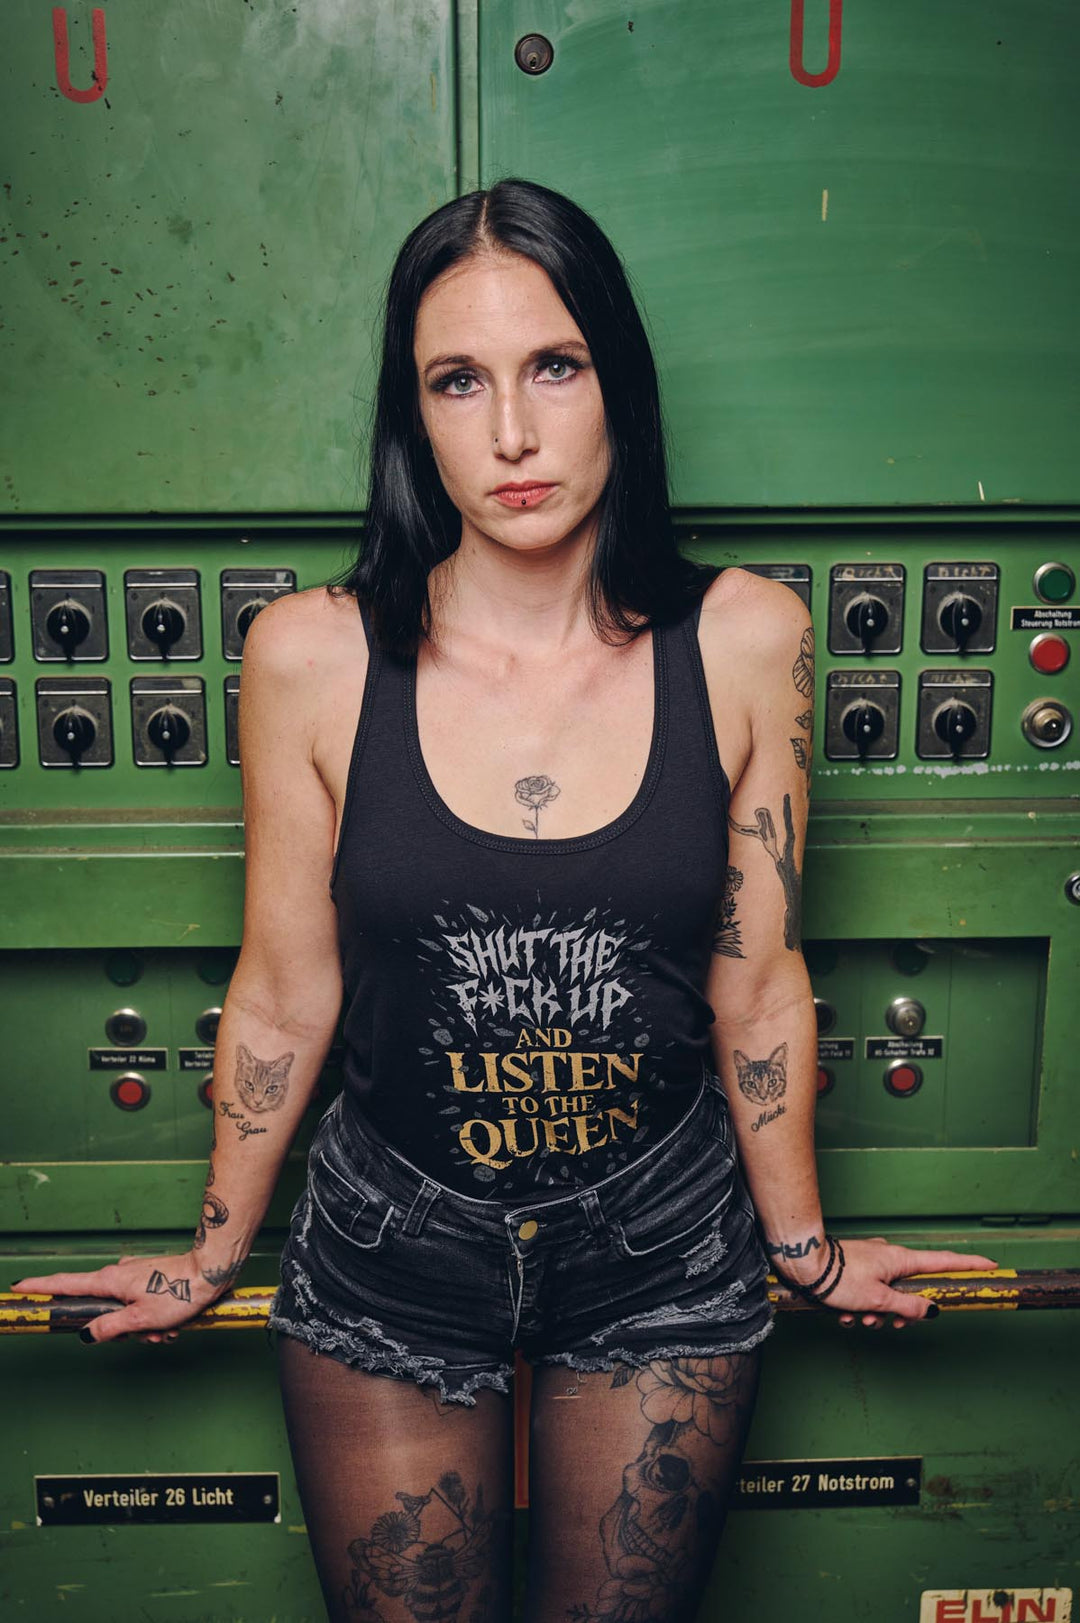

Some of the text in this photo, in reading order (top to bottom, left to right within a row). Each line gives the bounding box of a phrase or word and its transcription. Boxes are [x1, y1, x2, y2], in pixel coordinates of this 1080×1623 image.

[441, 924, 627, 985] SHUT THE
[567, 976, 634, 1032] UP
[515, 1027, 573, 1049] AND
[445, 1050, 644, 1094] LISTEN
[502, 1094, 594, 1118] TO THE
[458, 1100, 639, 1170] QUEEN
[737, 1473, 895, 1493] teiler 27 Notstrom
[83, 1486, 234, 1507] Verteiler 26 Licht
[935, 1598, 1057, 1623] ELIN
